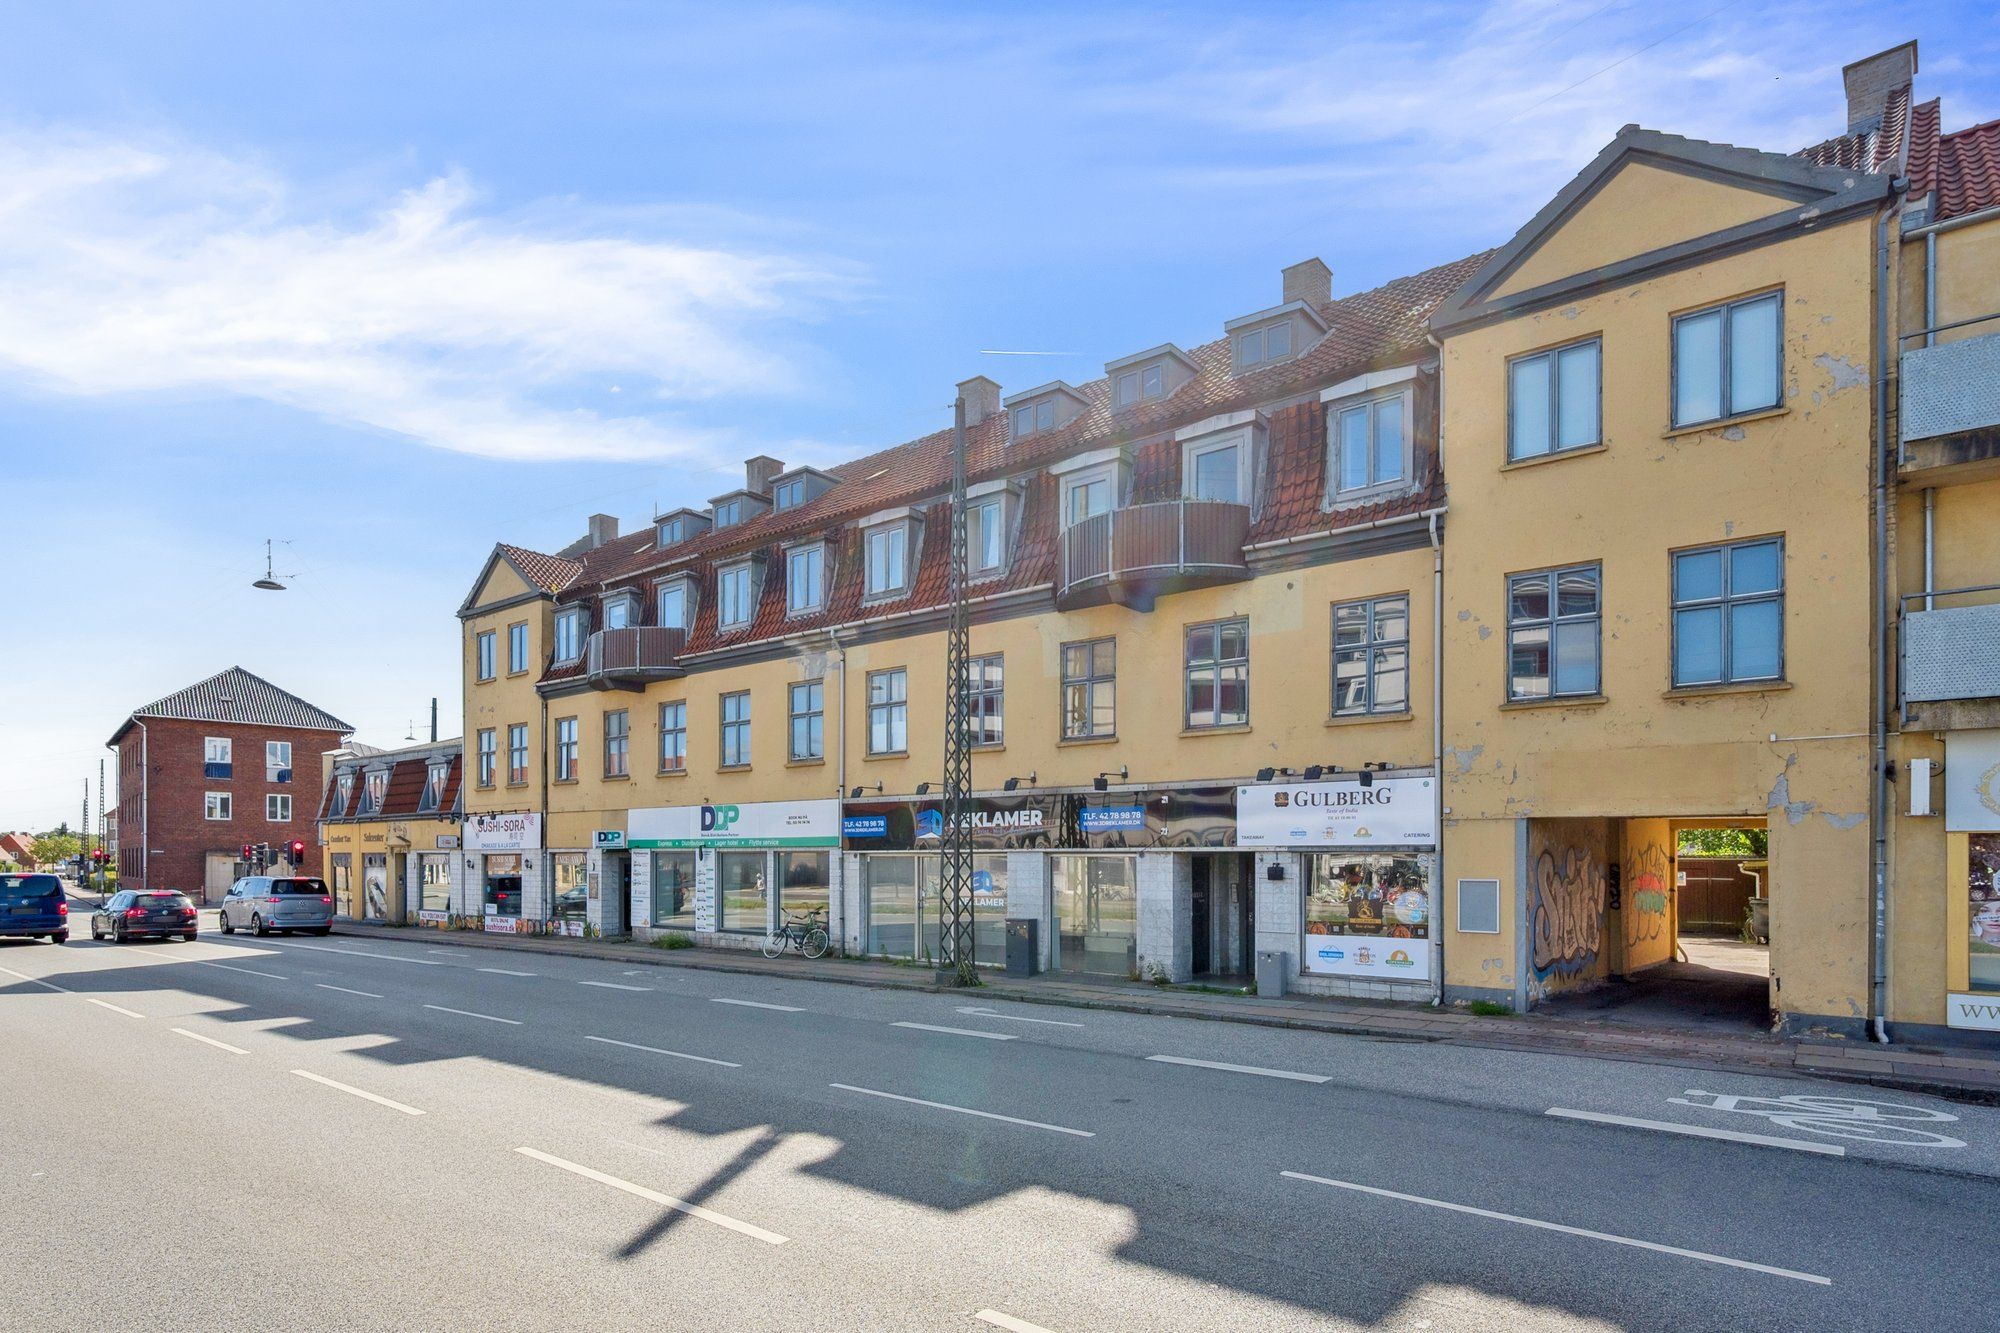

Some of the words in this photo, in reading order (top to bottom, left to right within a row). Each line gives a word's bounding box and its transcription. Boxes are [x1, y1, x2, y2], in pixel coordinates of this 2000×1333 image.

[1294, 788, 1392, 807] GULBERG
[478, 820, 526, 832] SUSHI-SORA
[701, 806, 740, 831] DDP
